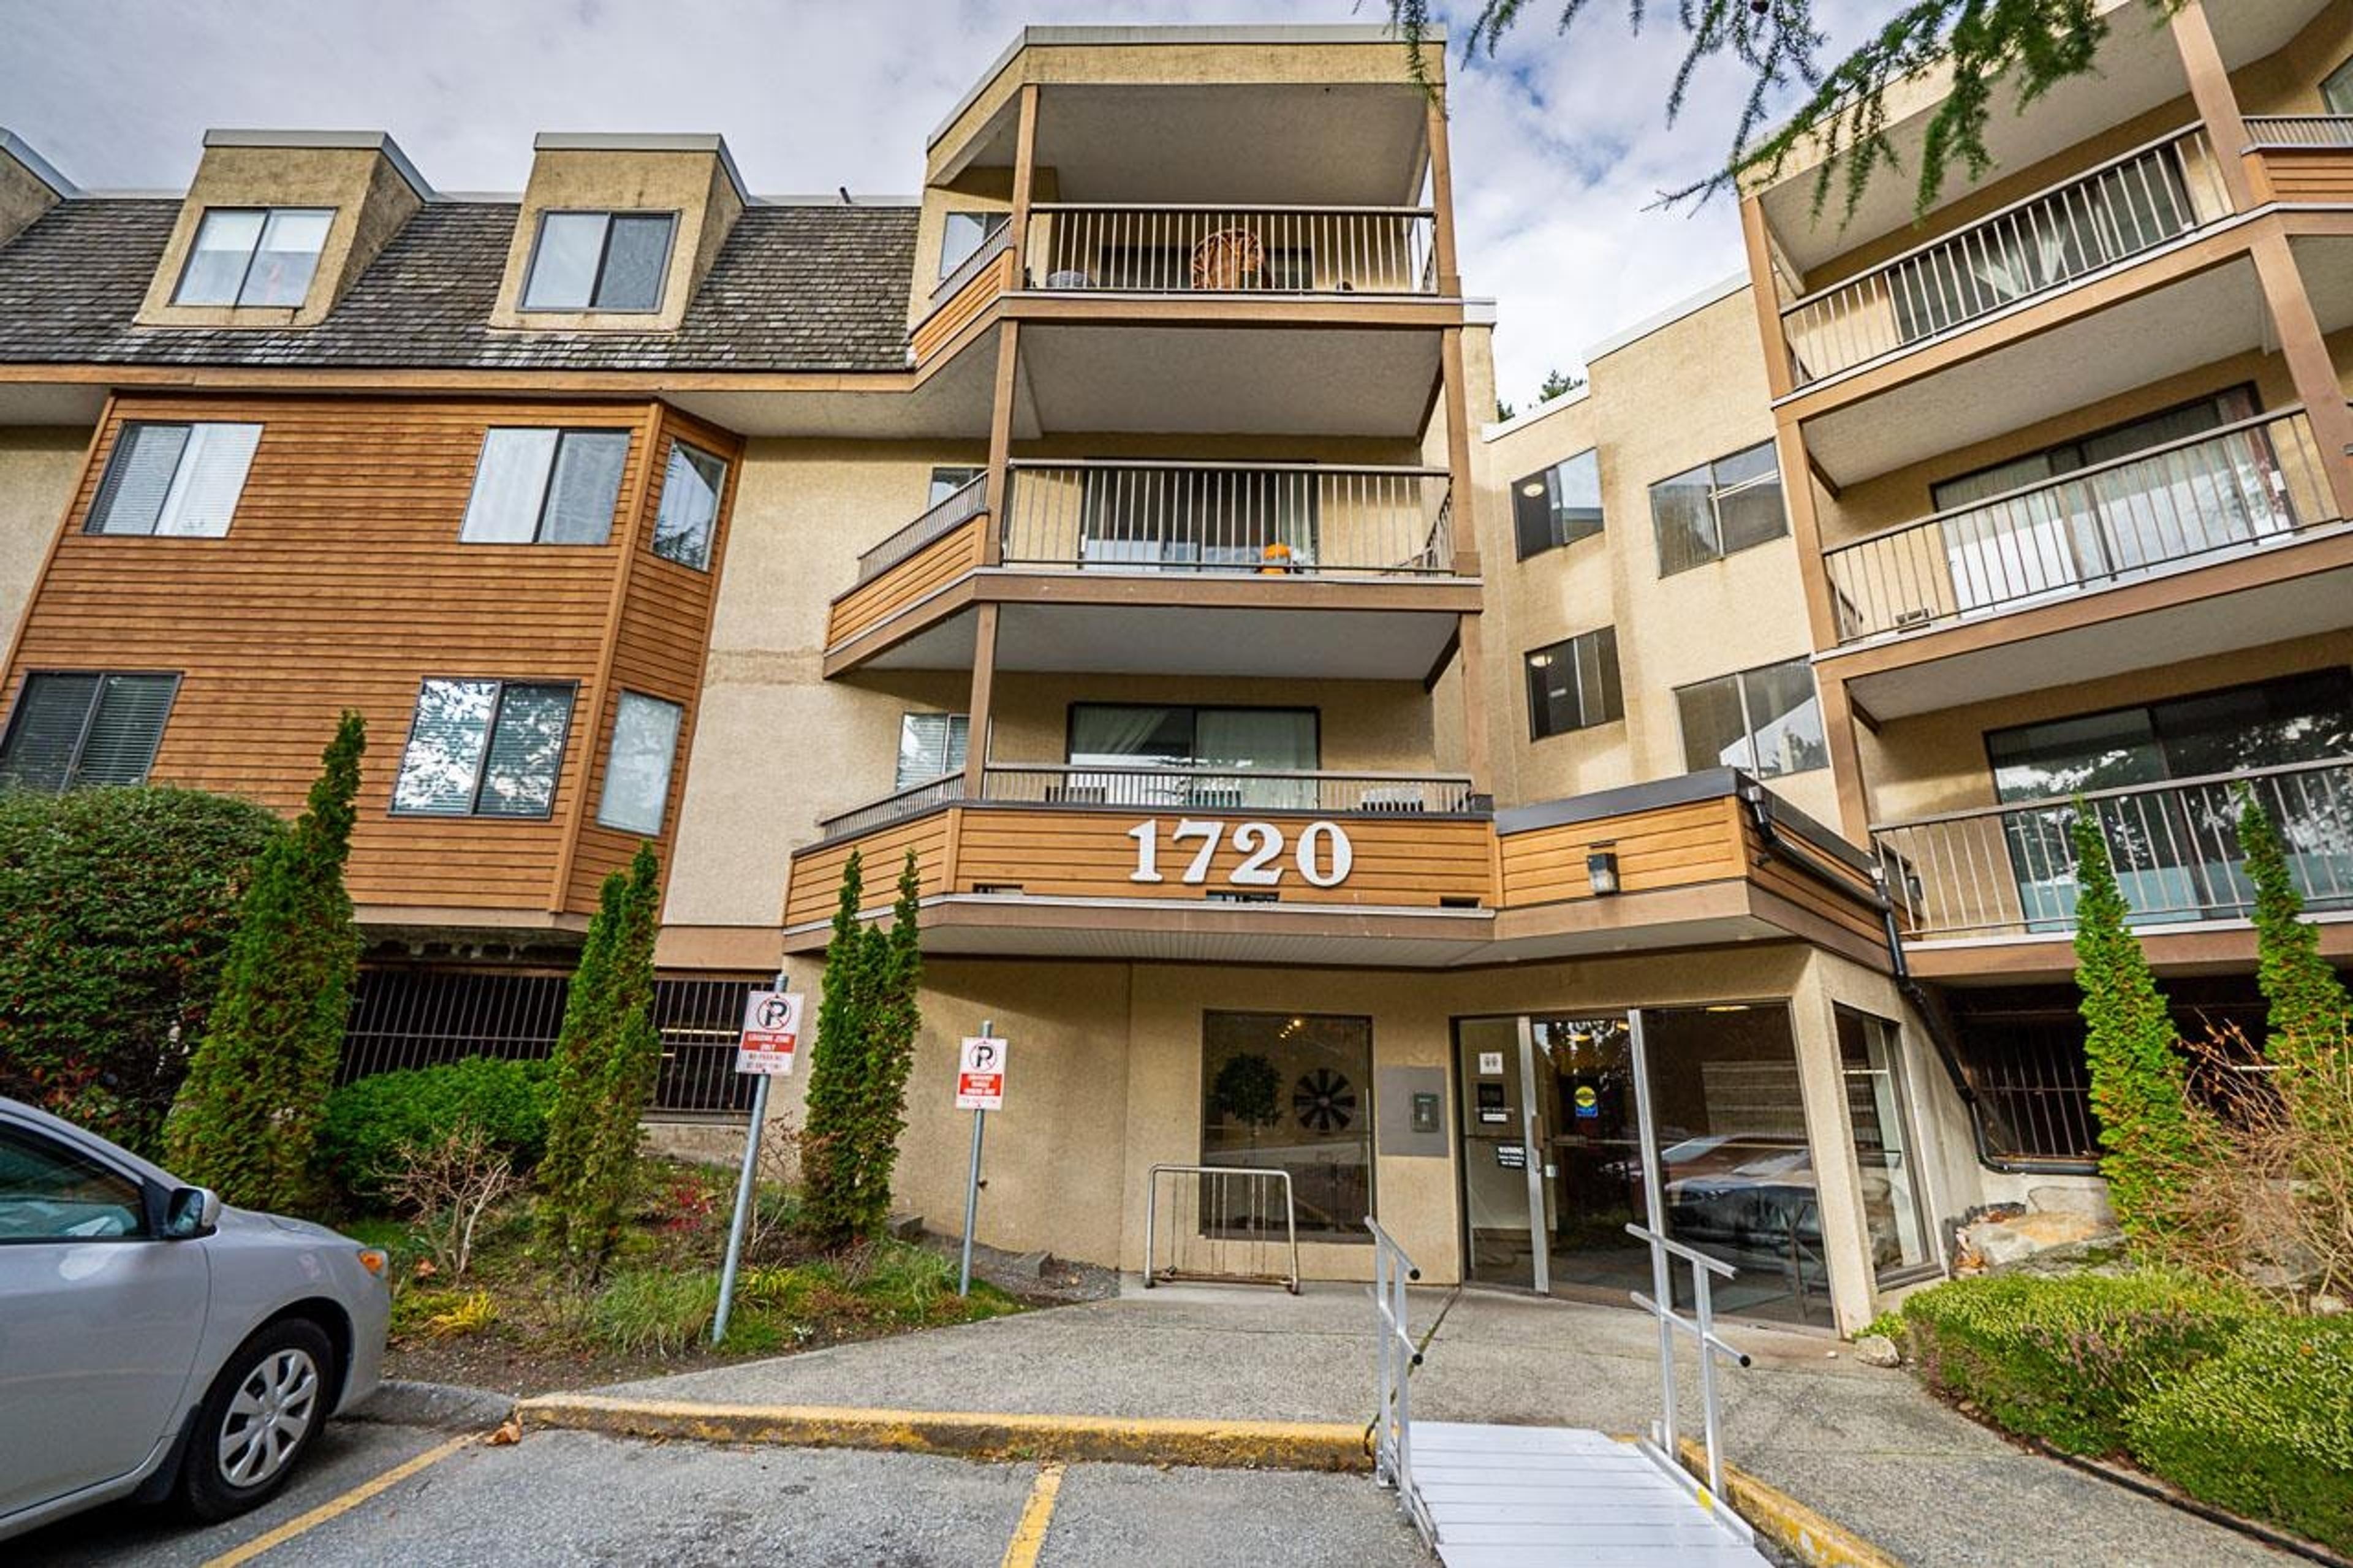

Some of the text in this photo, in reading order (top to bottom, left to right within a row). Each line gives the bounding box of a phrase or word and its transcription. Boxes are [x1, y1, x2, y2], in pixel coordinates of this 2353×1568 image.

[1128, 817, 1353, 887] 1720
[765, 1001, 787, 1026] P
[976, 1045, 993, 1067] P
